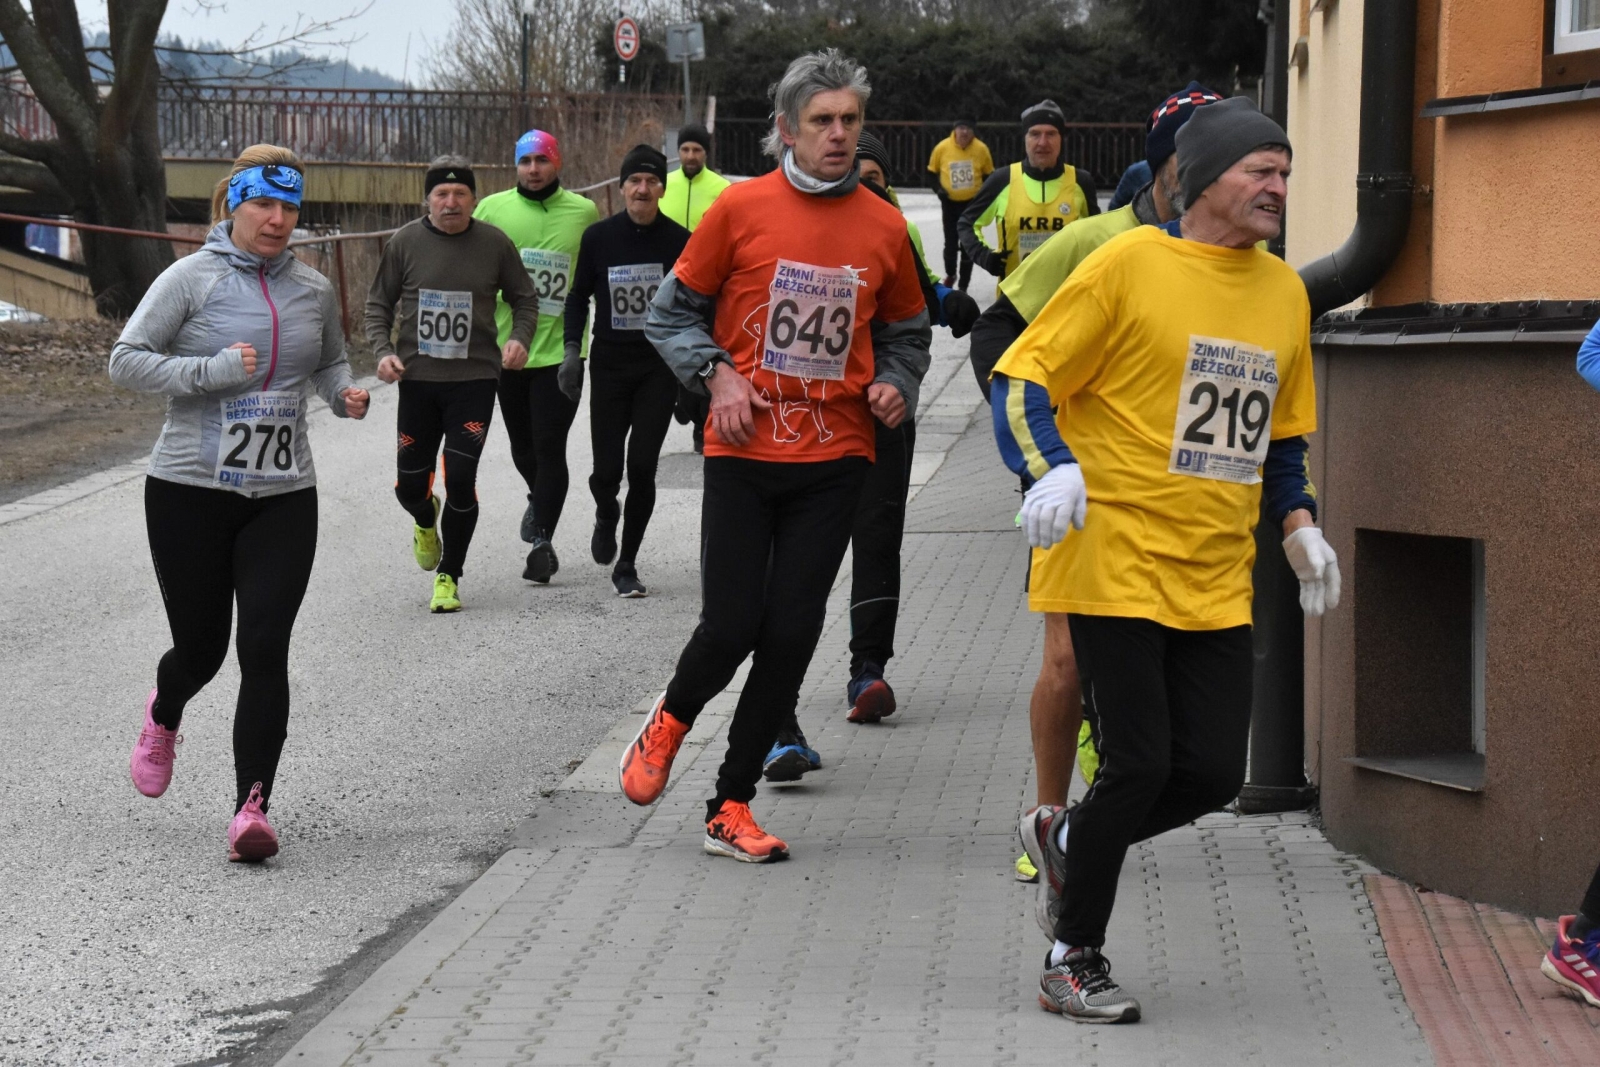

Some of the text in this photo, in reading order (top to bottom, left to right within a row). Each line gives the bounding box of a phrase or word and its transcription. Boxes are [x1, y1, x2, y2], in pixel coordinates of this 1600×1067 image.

[1020, 217, 1064, 231] KRB
[554, 262, 569, 270] LIGA
[774, 278, 828, 297] BĚŽECKÁ
[832, 287, 853, 299] LIGA
[419, 310, 469, 343] 506
[770, 299, 852, 356] 643
[1191, 357, 1246, 379] BĚŽECKÁ
[226, 406, 296, 420] BĚŽECKÁ LIGA
[1183, 381, 1270, 452] 219
[223, 423, 292, 471] 278
